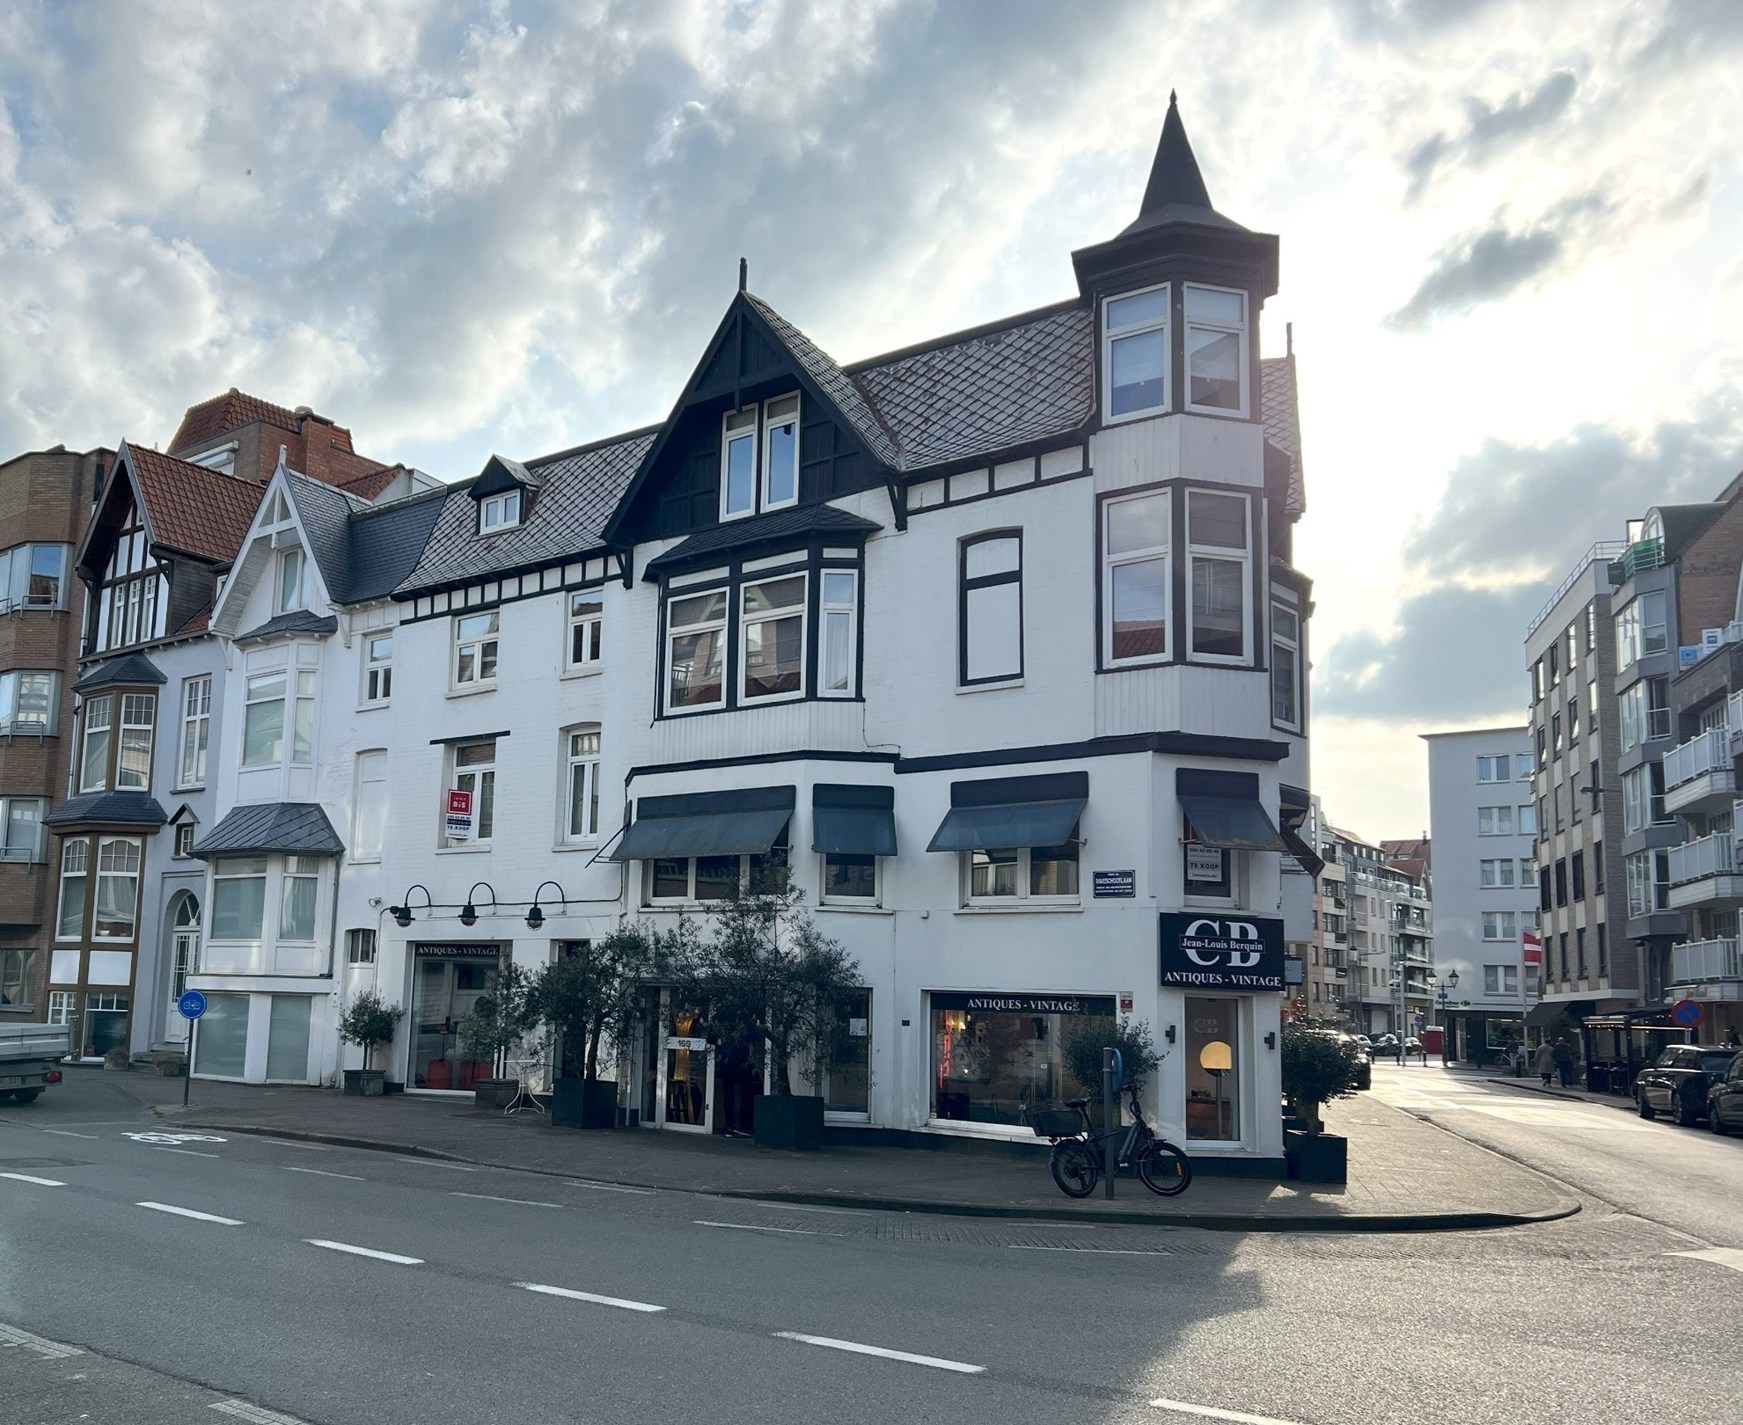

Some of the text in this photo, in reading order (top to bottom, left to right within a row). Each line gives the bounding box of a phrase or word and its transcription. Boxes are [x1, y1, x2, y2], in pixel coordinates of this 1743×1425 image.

[418, 946, 457, 955] ANTIQUES
[463, 947, 498, 956] VINTAGE
[1182, 938, 1263, 952] Jean-Louis Berquin
[1164, 971, 1223, 985] ANTIQUES
[1231, 974, 1282, 987] VINTAGE
[967, 998, 1022, 1010] ANTIQUES
[1030, 1000, 1080, 1012] VINTAGE
